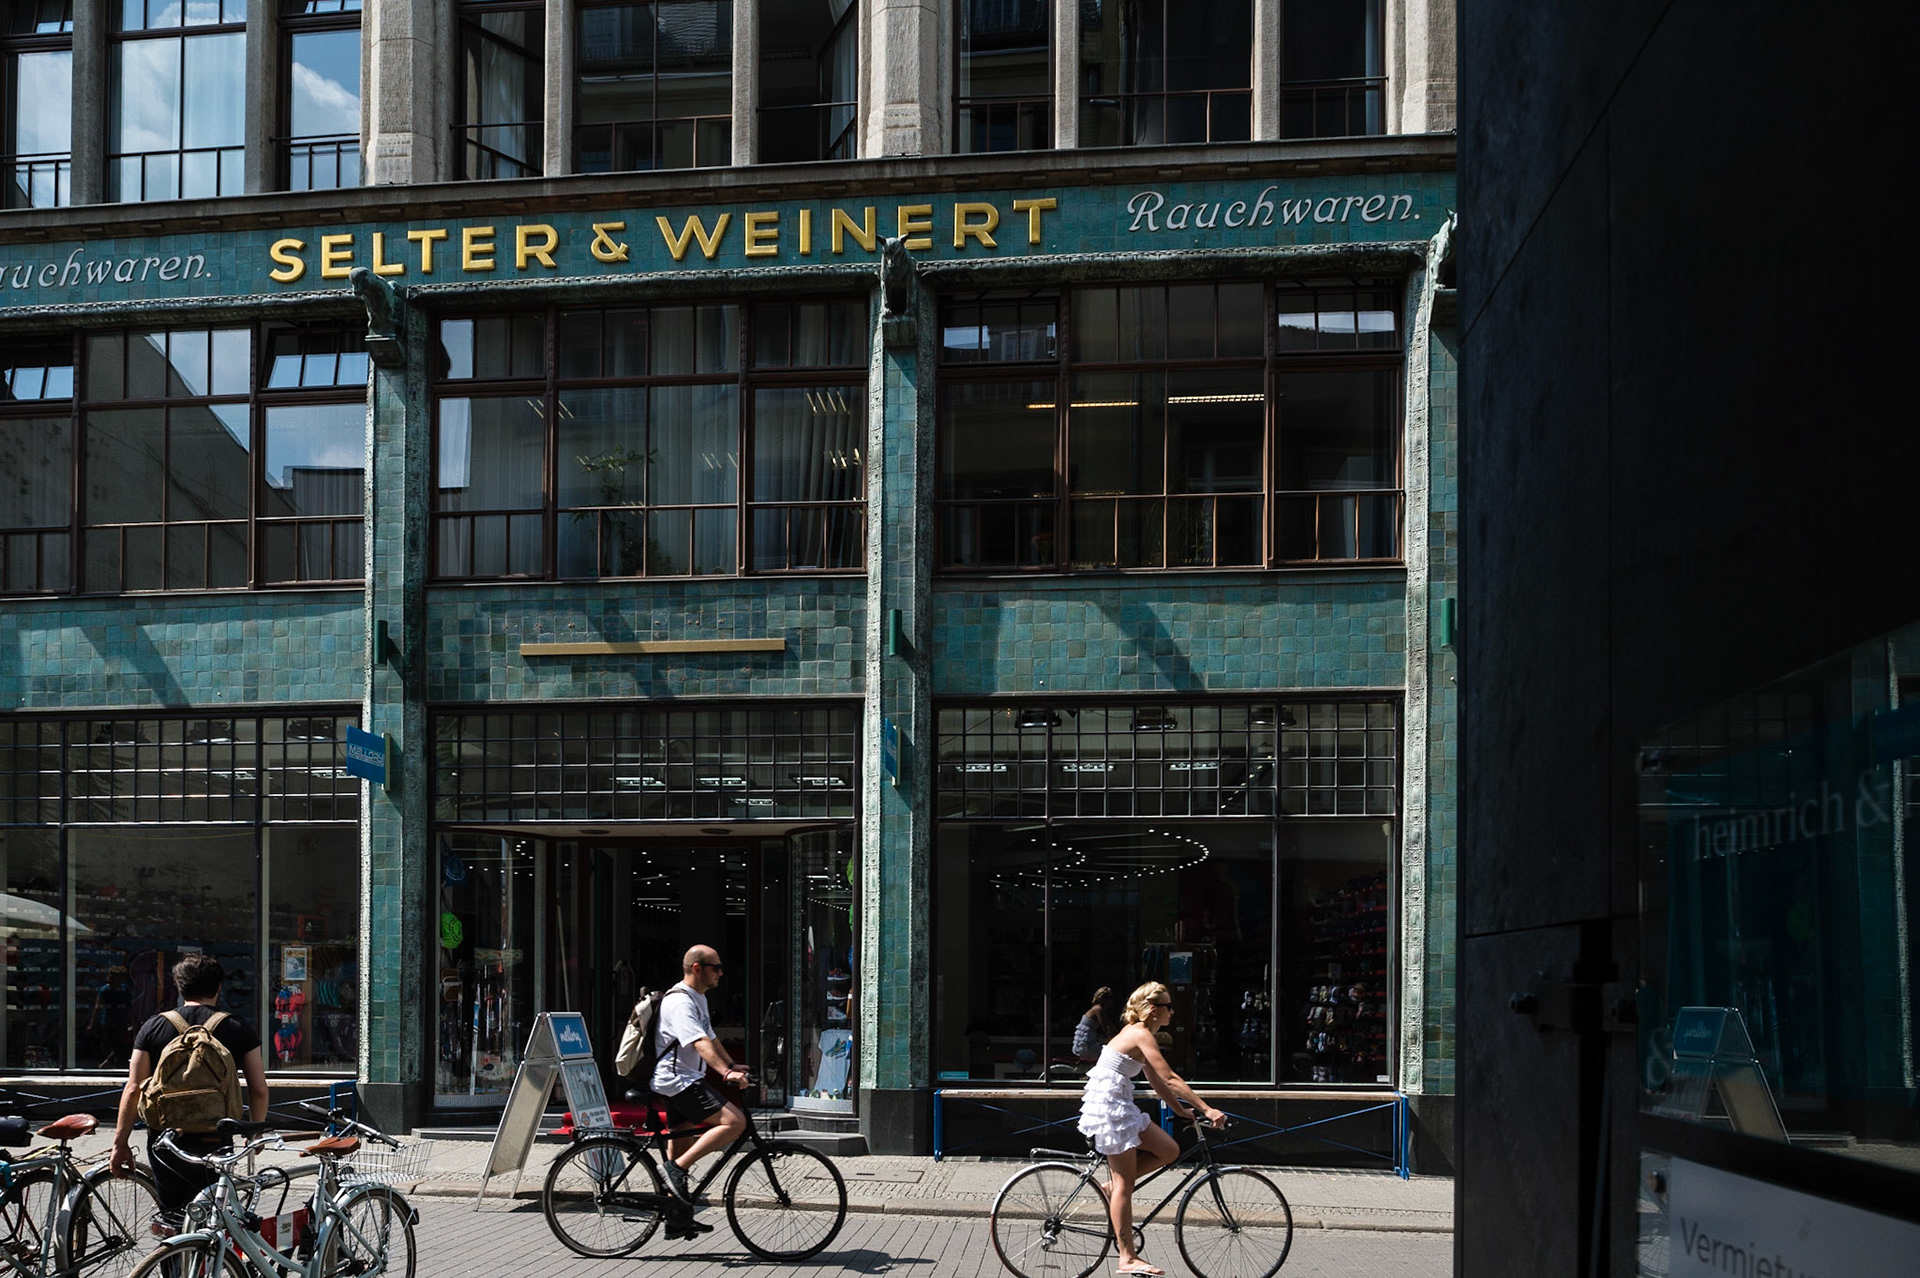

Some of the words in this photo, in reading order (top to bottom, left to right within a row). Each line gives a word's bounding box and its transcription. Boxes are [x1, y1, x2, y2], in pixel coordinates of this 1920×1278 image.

[269, 223, 560, 283] SELTER
[590, 221, 629, 263] &
[655, 197, 1058, 262] WEINERT
[1127, 185, 1420, 232] Rauchwaren.
[1694, 780, 1846, 861] heimrich
